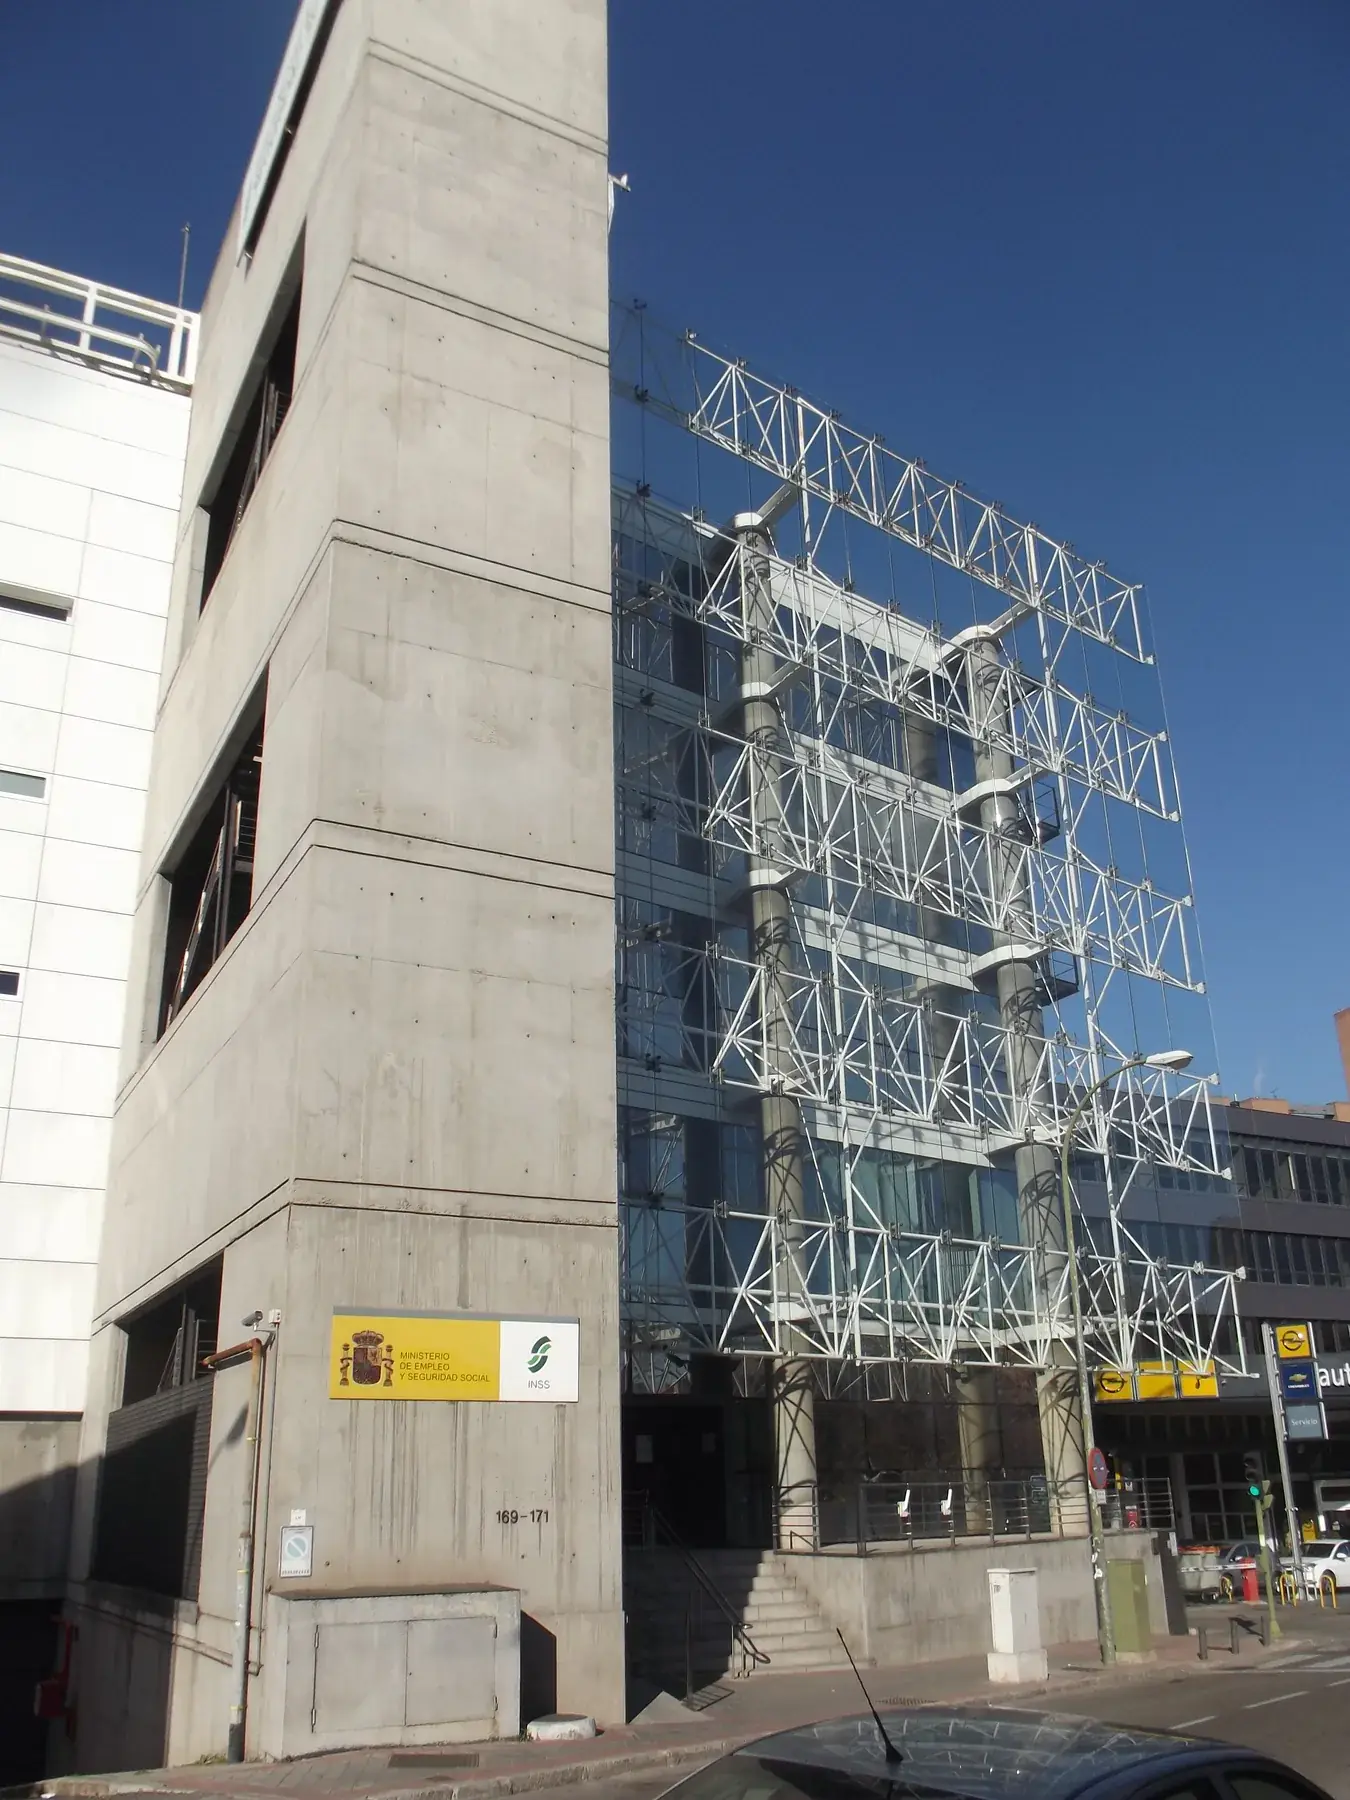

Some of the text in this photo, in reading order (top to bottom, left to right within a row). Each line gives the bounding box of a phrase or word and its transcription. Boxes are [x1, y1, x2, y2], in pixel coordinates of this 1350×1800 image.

[400, 1351, 450, 1361] MINISTERIO
[399, 1362, 450, 1371] DE EMPLEO
[400, 1372, 490, 1383] Y SEGURIDAD SOCIAL
[528, 1379, 550, 1389] INSS
[495, 1509, 549, 1524] 169-171
